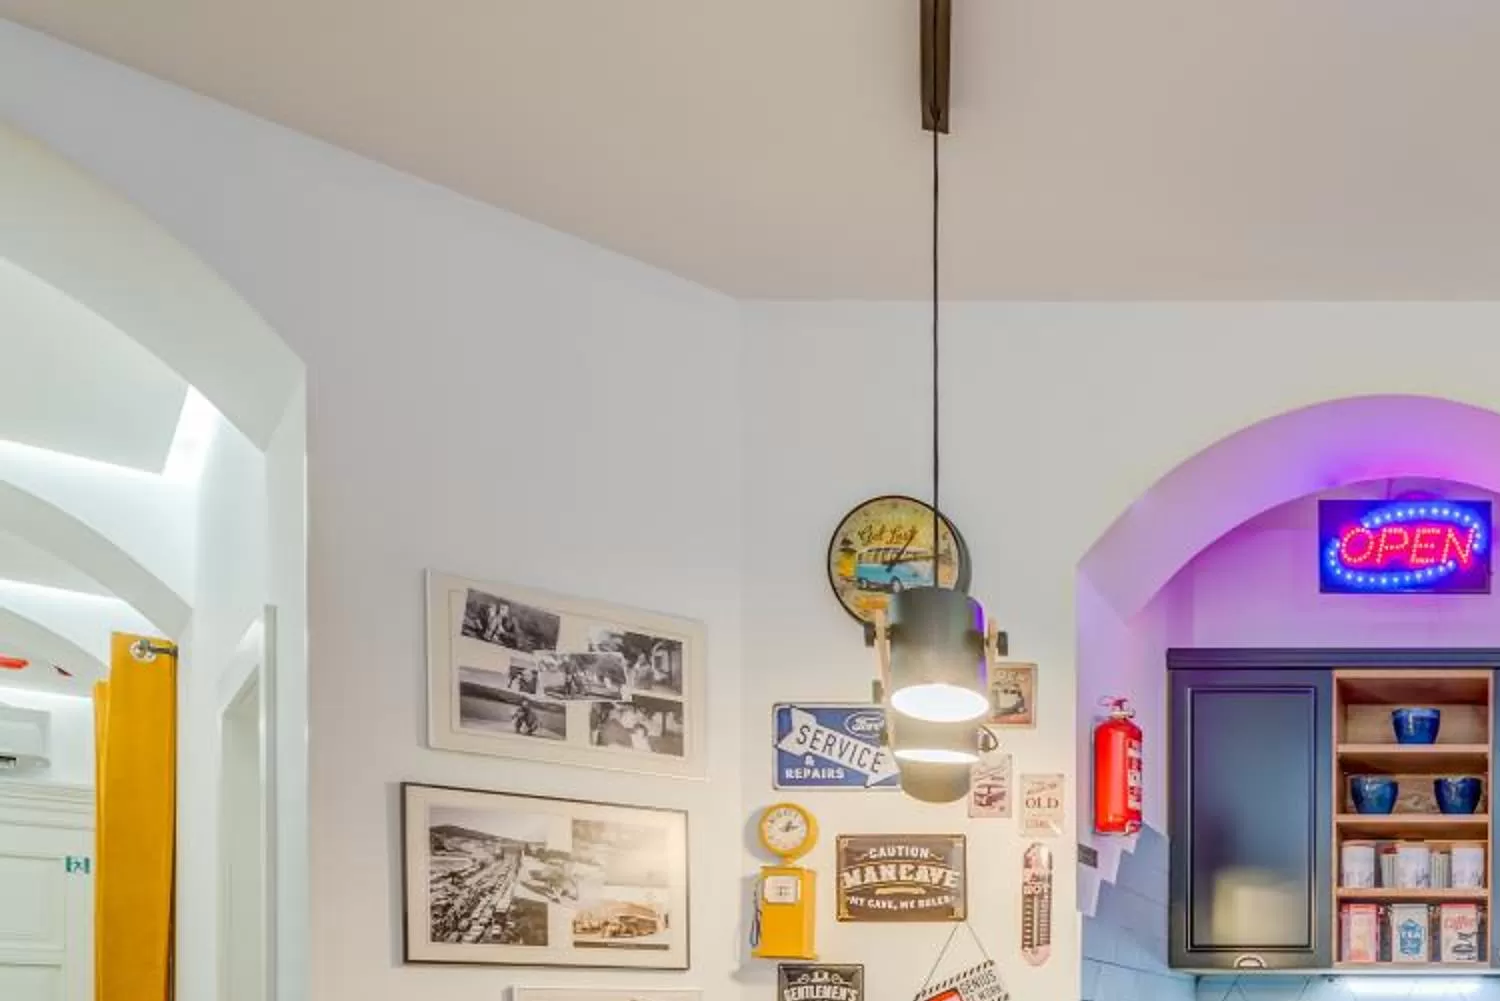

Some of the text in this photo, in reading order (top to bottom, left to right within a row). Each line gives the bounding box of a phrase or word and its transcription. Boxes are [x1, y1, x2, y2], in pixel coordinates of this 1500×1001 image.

[1341, 527, 1475, 565] OPEN
[796, 724, 886, 774] SERVICE
[785, 767, 845, 779] REPAIRS
[1025, 796, 1059, 809] OLD
[869, 846, 929, 859] CAUTION
